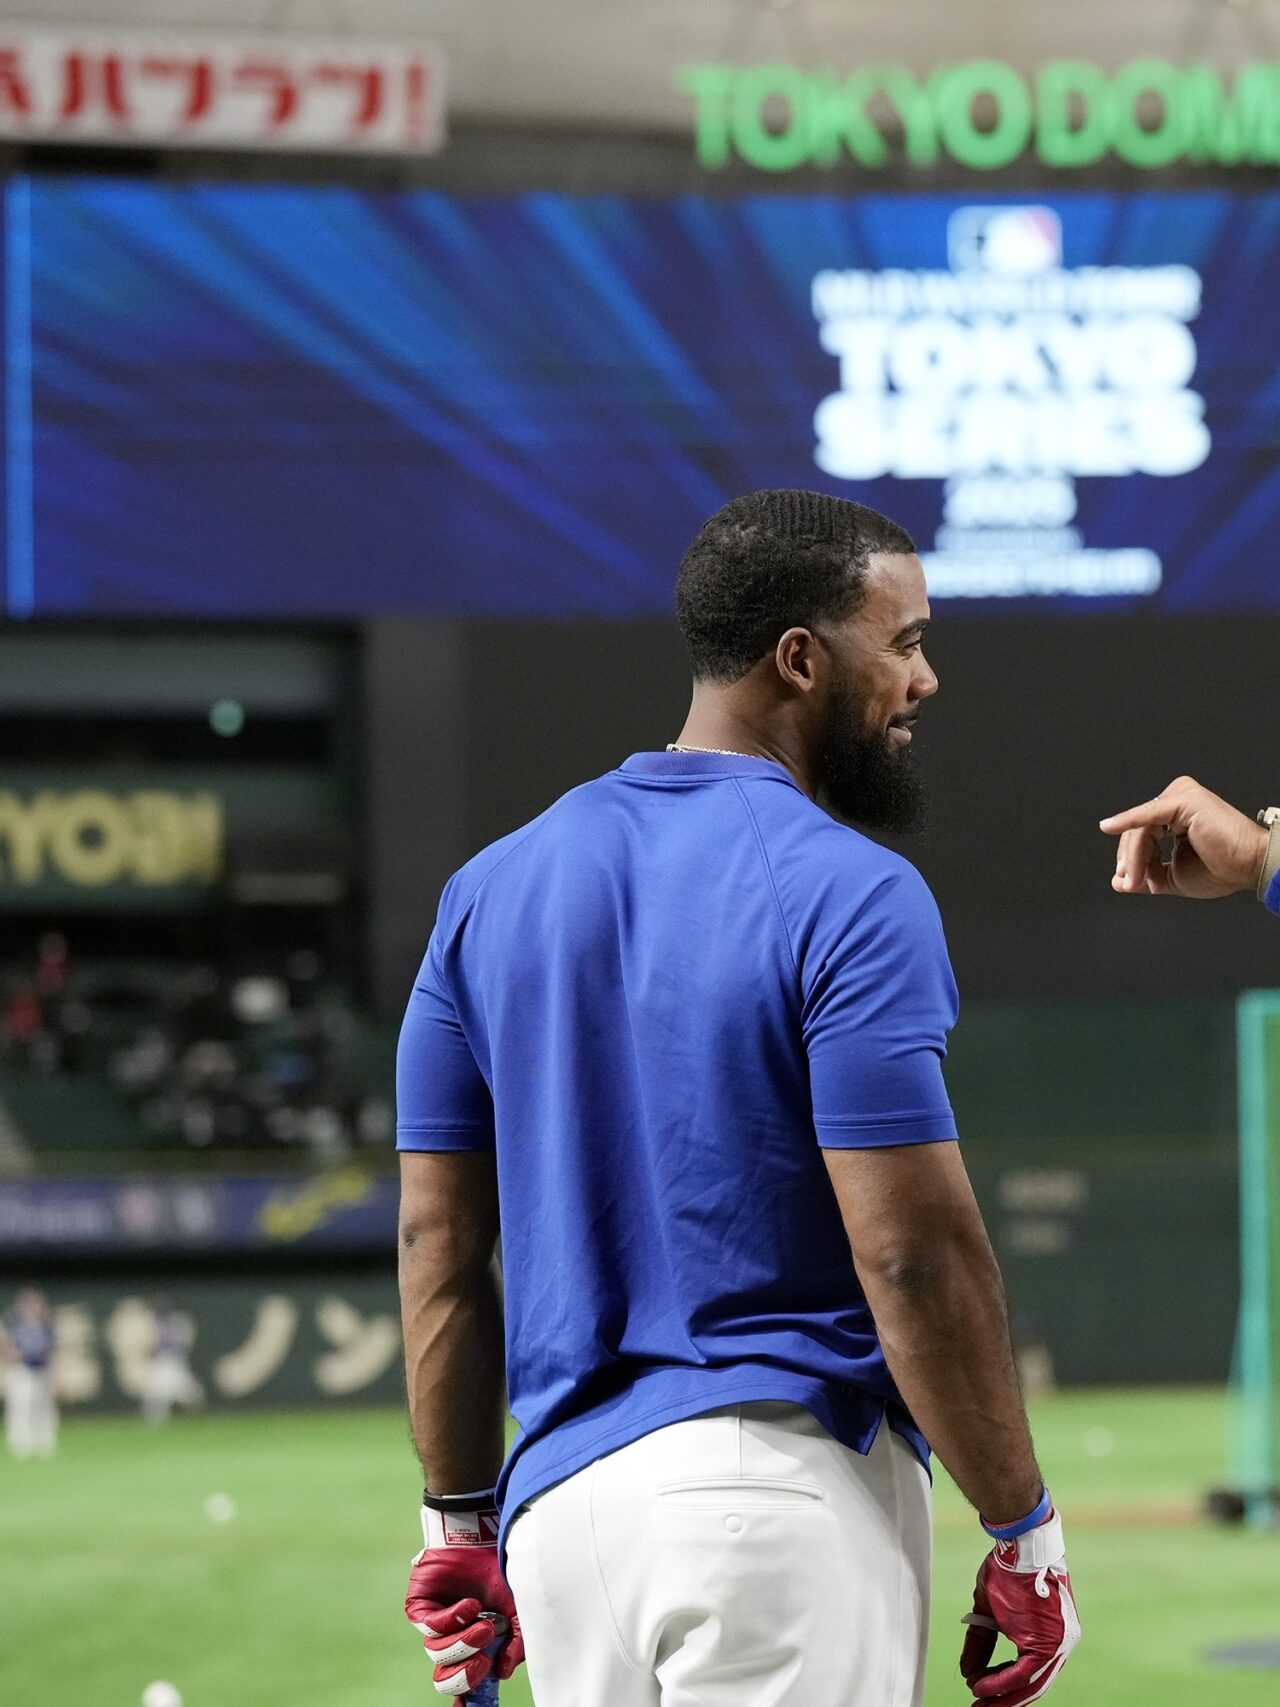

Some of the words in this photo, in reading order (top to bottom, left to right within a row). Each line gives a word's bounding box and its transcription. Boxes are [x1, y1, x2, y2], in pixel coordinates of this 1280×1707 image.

[682, 58, 1031, 171] TOKYO
[820, 314, 1197, 394] TOKYO
[814, 391, 1211, 479] SERIES
